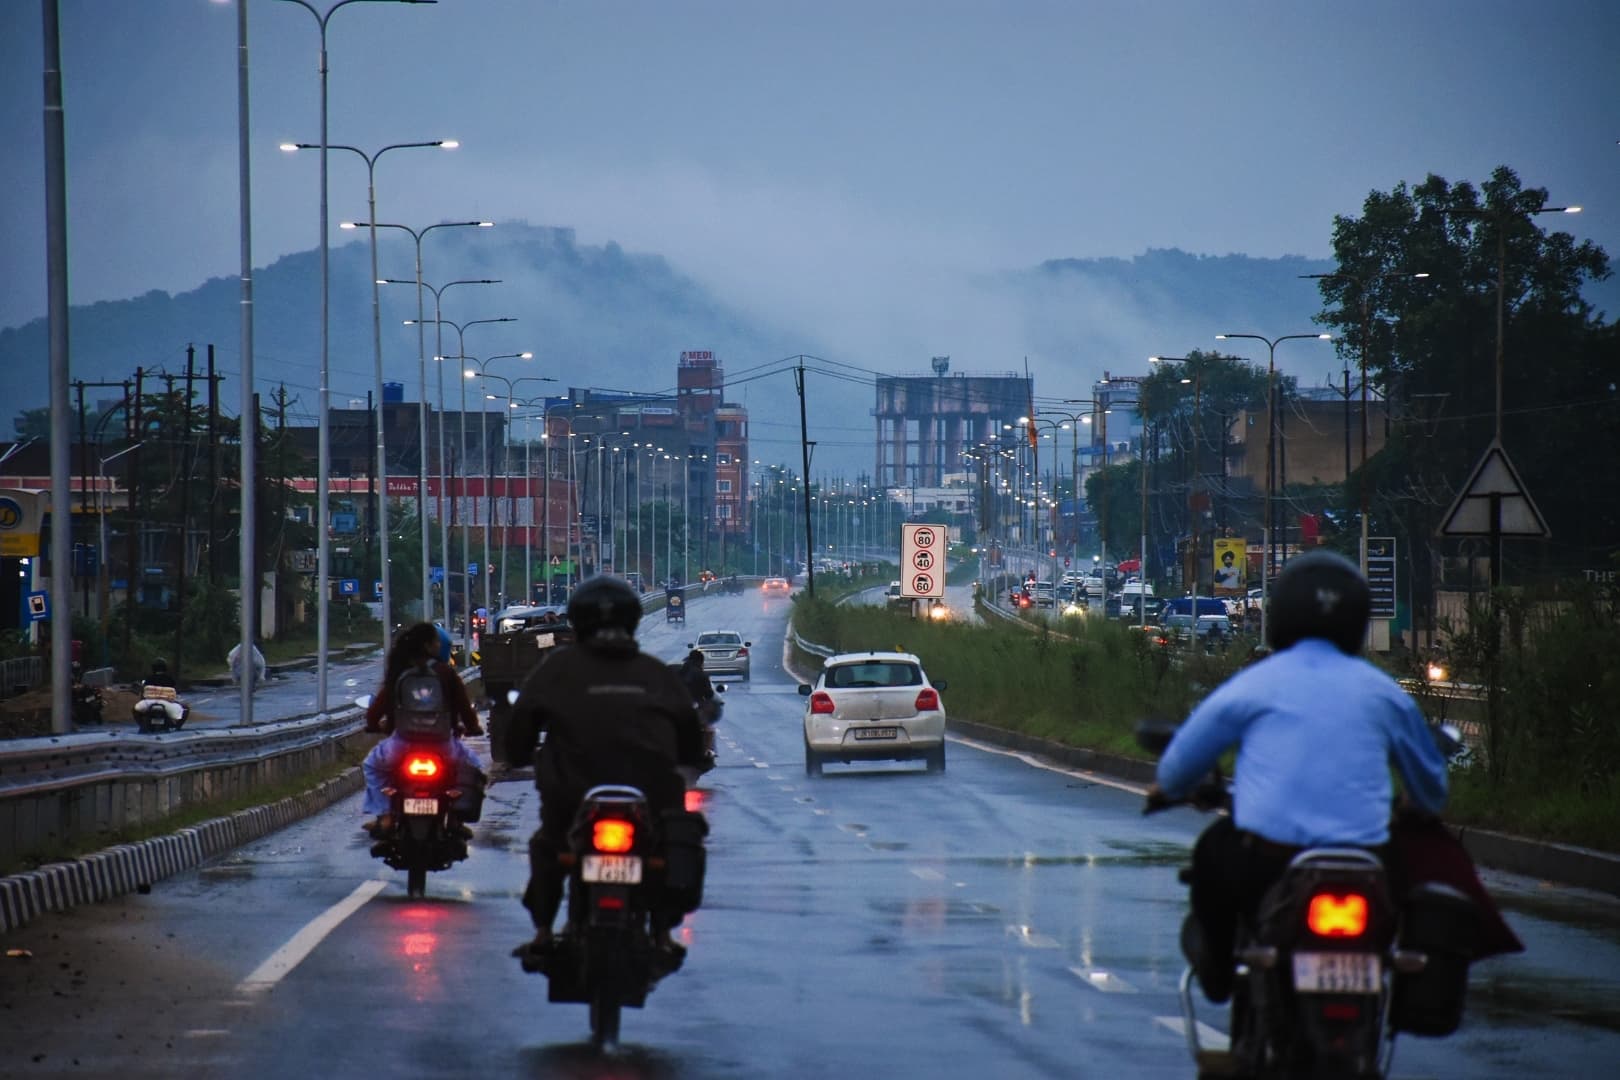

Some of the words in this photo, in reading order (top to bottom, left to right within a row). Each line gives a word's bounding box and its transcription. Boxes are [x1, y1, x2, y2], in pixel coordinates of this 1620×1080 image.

[688, 351, 713, 360] MEDI
[918, 536, 931, 545] 80
[917, 559, 930, 568] 40
[916, 582, 929, 591] 60
